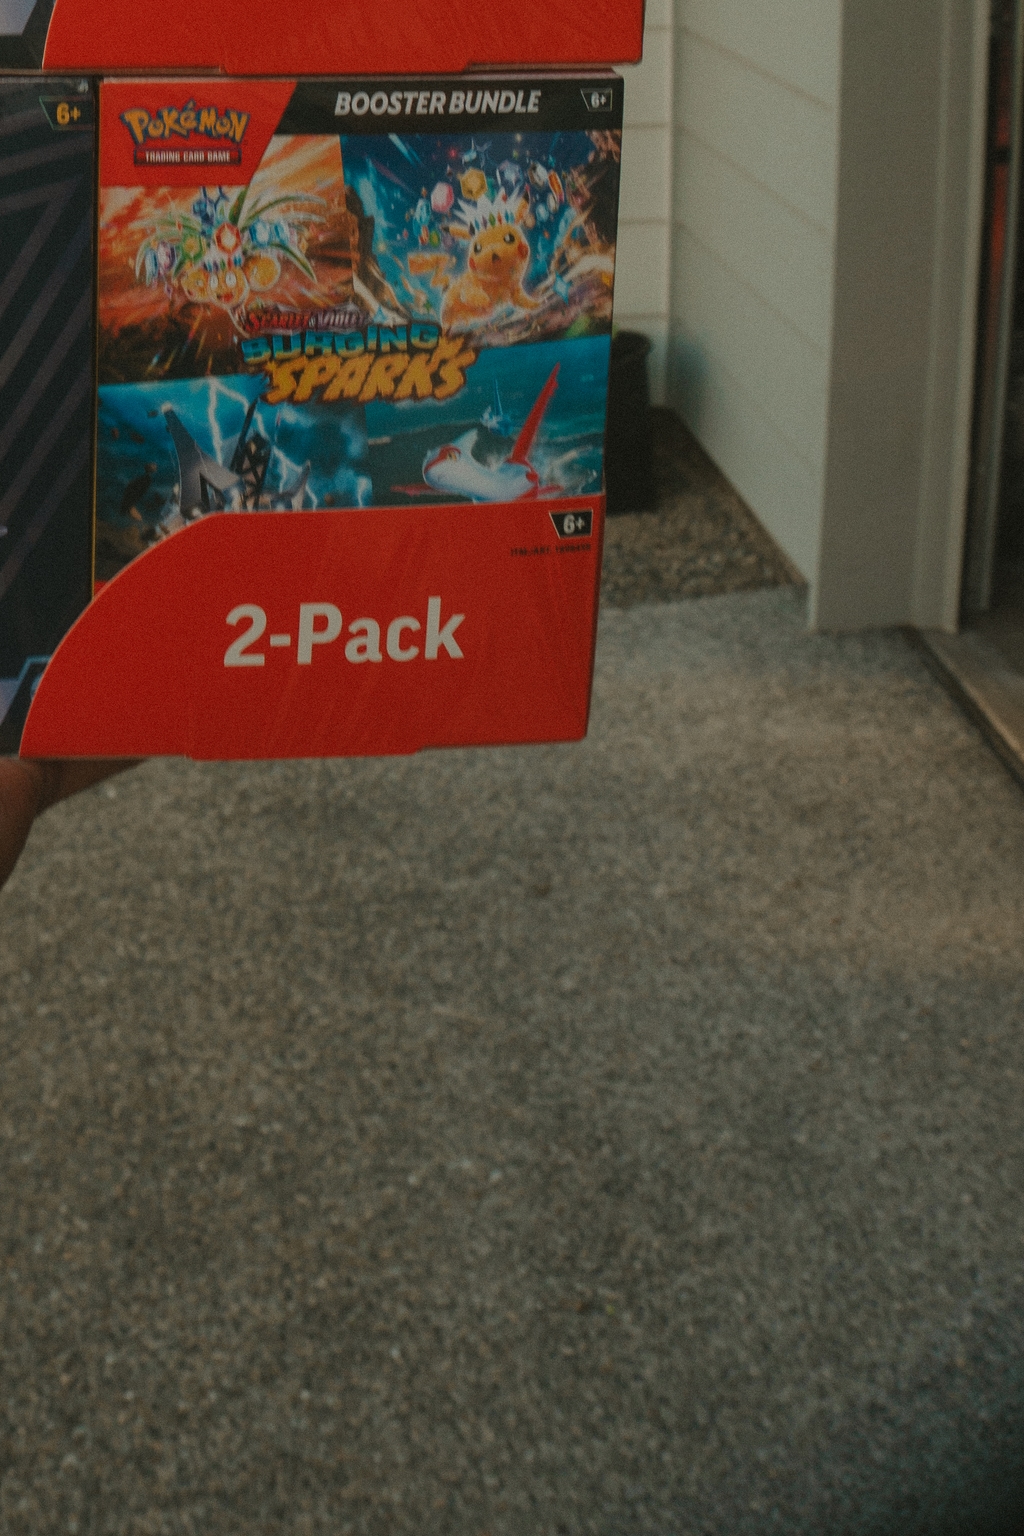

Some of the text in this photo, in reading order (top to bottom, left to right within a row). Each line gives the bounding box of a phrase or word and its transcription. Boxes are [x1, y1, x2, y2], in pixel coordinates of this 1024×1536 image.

[335, 89, 541, 116] BOOSTER BUNDLE
[590, 92, 607, 108] 6+
[57, 101, 81, 125] 6+
[145, 150, 231, 162] TRADING CARD GAME
[241, 323, 439, 363] SURGING
[265, 334, 476, 404] SPARKS
[563, 514, 585, 535] 6+
[223, 595, 467, 668] 2-Pack
